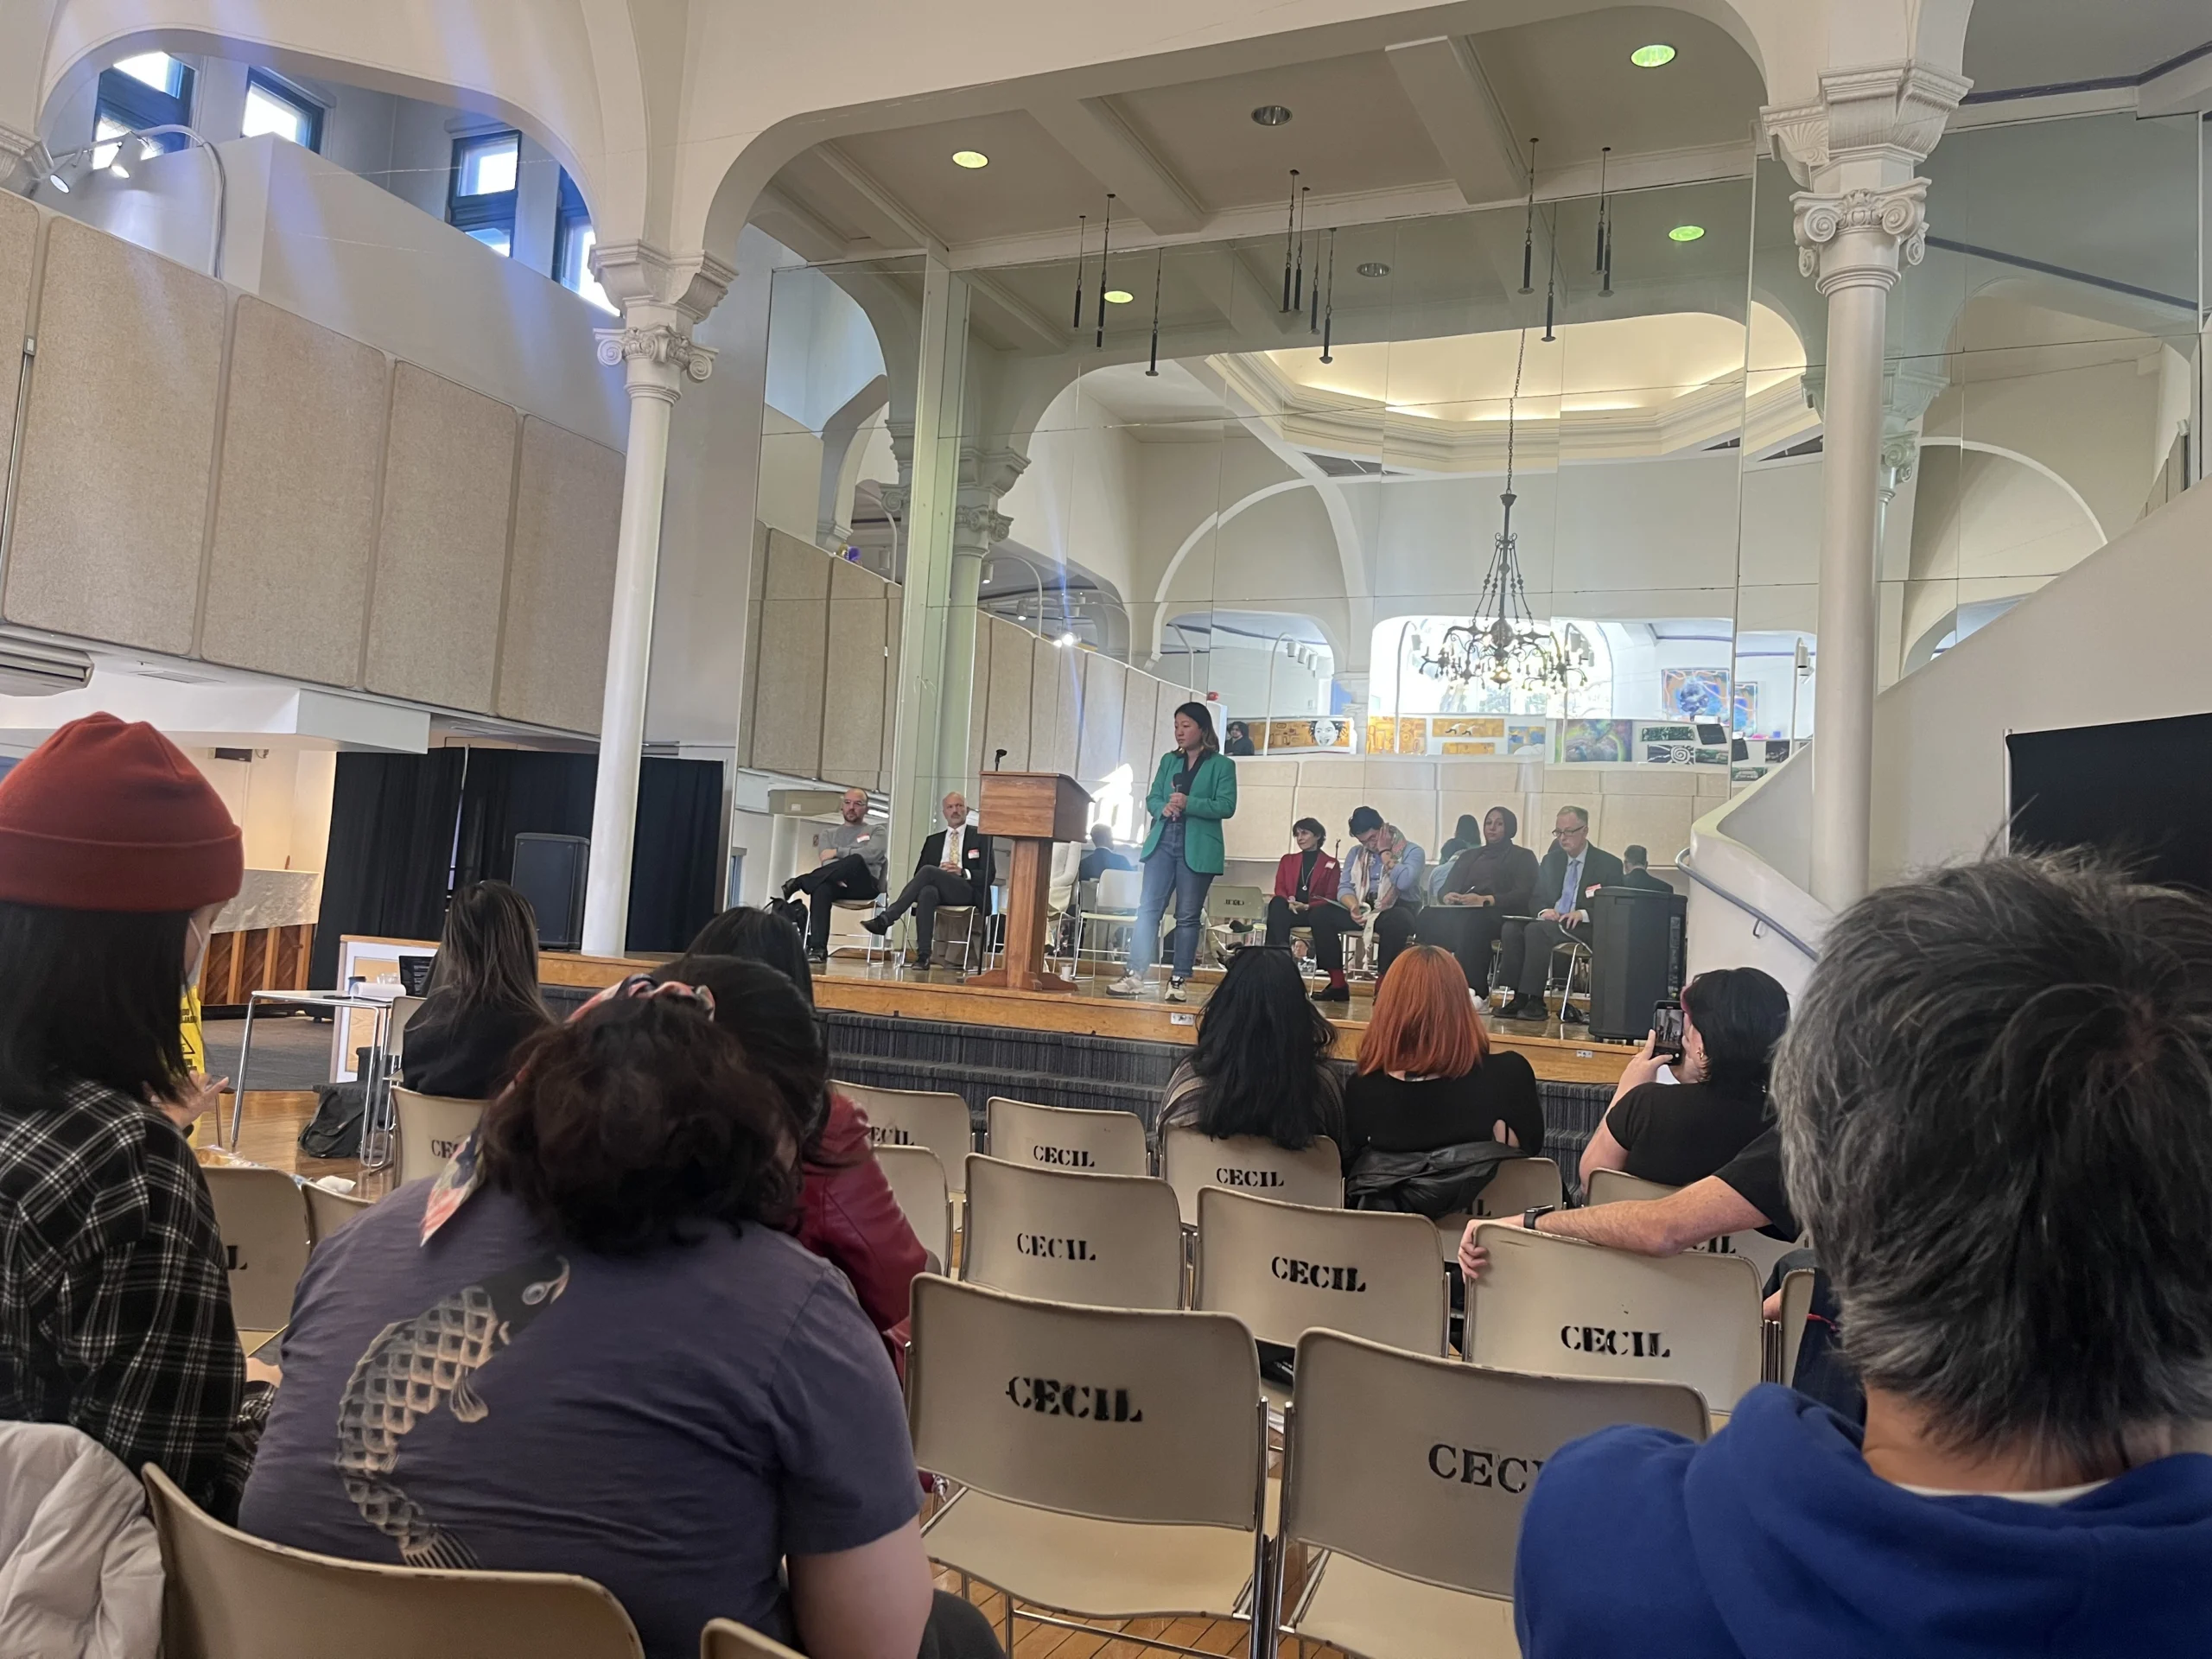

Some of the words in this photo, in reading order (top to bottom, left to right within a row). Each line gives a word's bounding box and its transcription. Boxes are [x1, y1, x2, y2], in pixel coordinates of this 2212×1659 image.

[870, 1126, 914, 1146] ECIL
[1033, 1145, 1095, 1166] CECIL
[1216, 1167, 1284, 1187] CECIL
[1017, 1233, 1096, 1261] CECIL
[1271, 1256, 1366, 1293] CECIL
[1560, 1325, 1670, 1357] CECIL
[1006, 1376, 1142, 1422] CECIL
